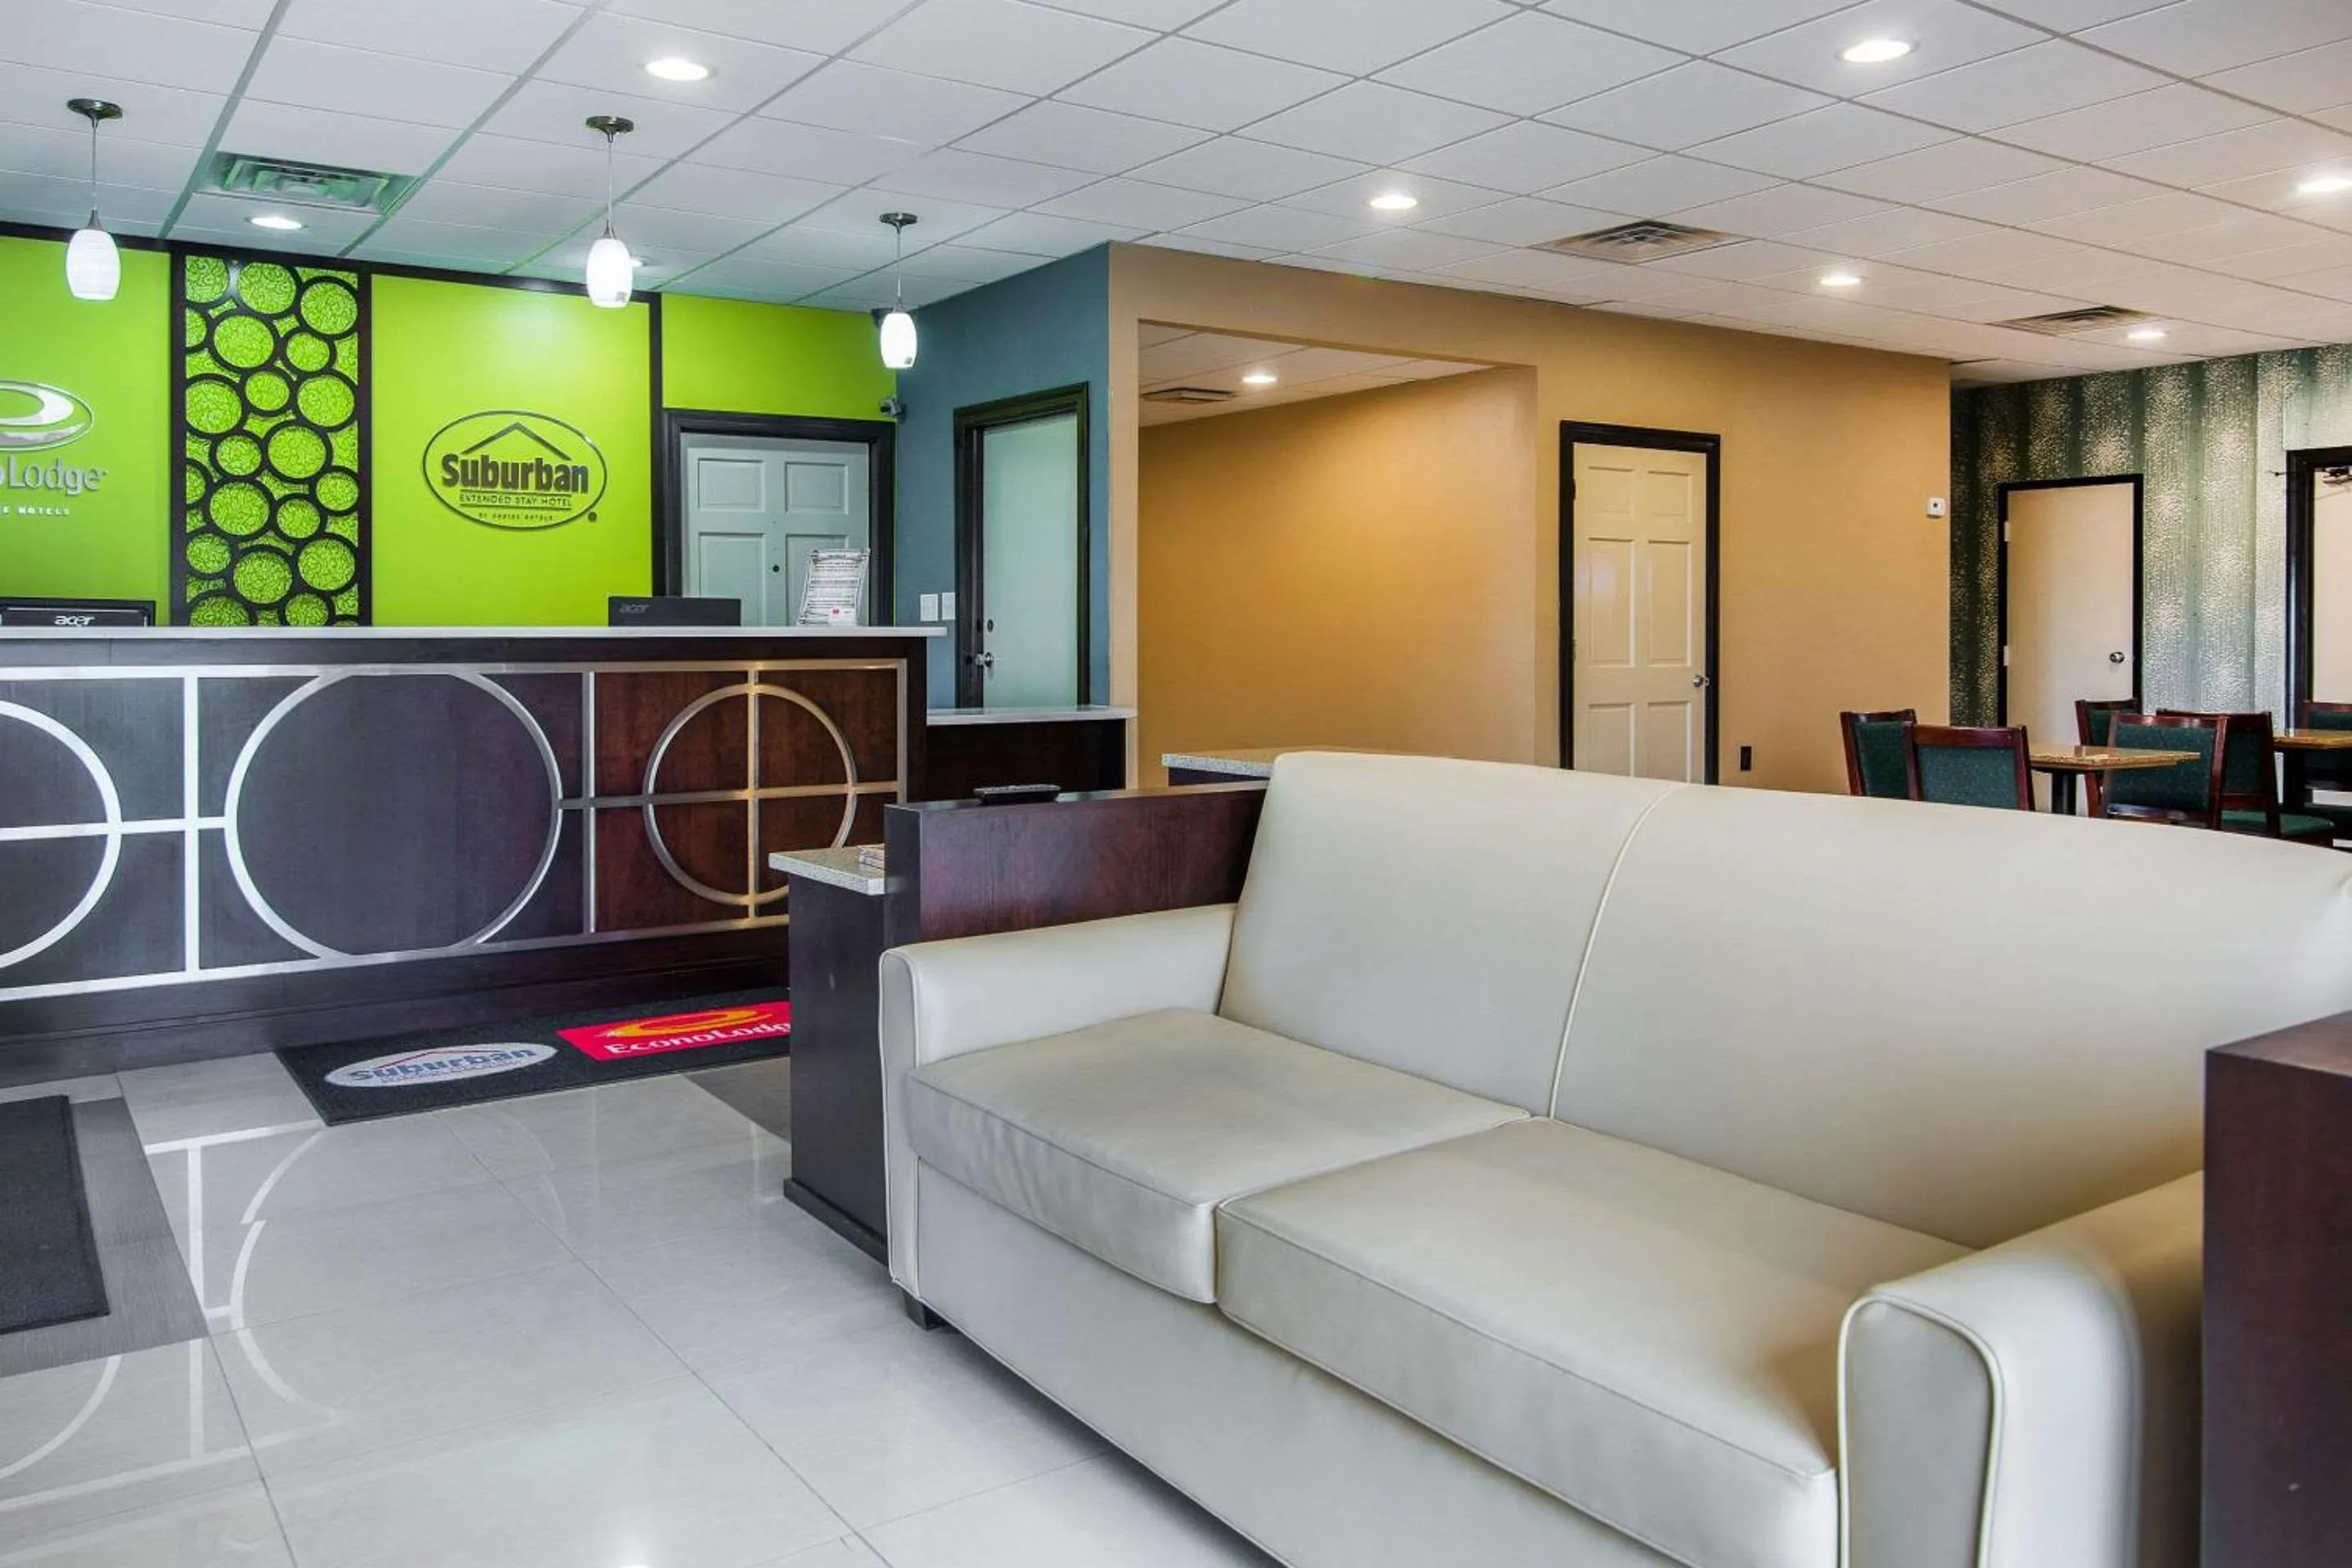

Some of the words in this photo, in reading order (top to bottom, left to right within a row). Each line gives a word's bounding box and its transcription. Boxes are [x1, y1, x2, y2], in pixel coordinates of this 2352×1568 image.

[0, 453, 100, 497] Lodge
[442, 453, 589, 493] Suburban
[459, 492, 512, 504] EXTENDED
[514, 496, 537, 506] STAY
[541, 497, 571, 507] HOTEL
[54, 615, 96, 626] acer
[604, 1022, 791, 1054] EconoLodg
[349, 1048, 537, 1081] Suburban
